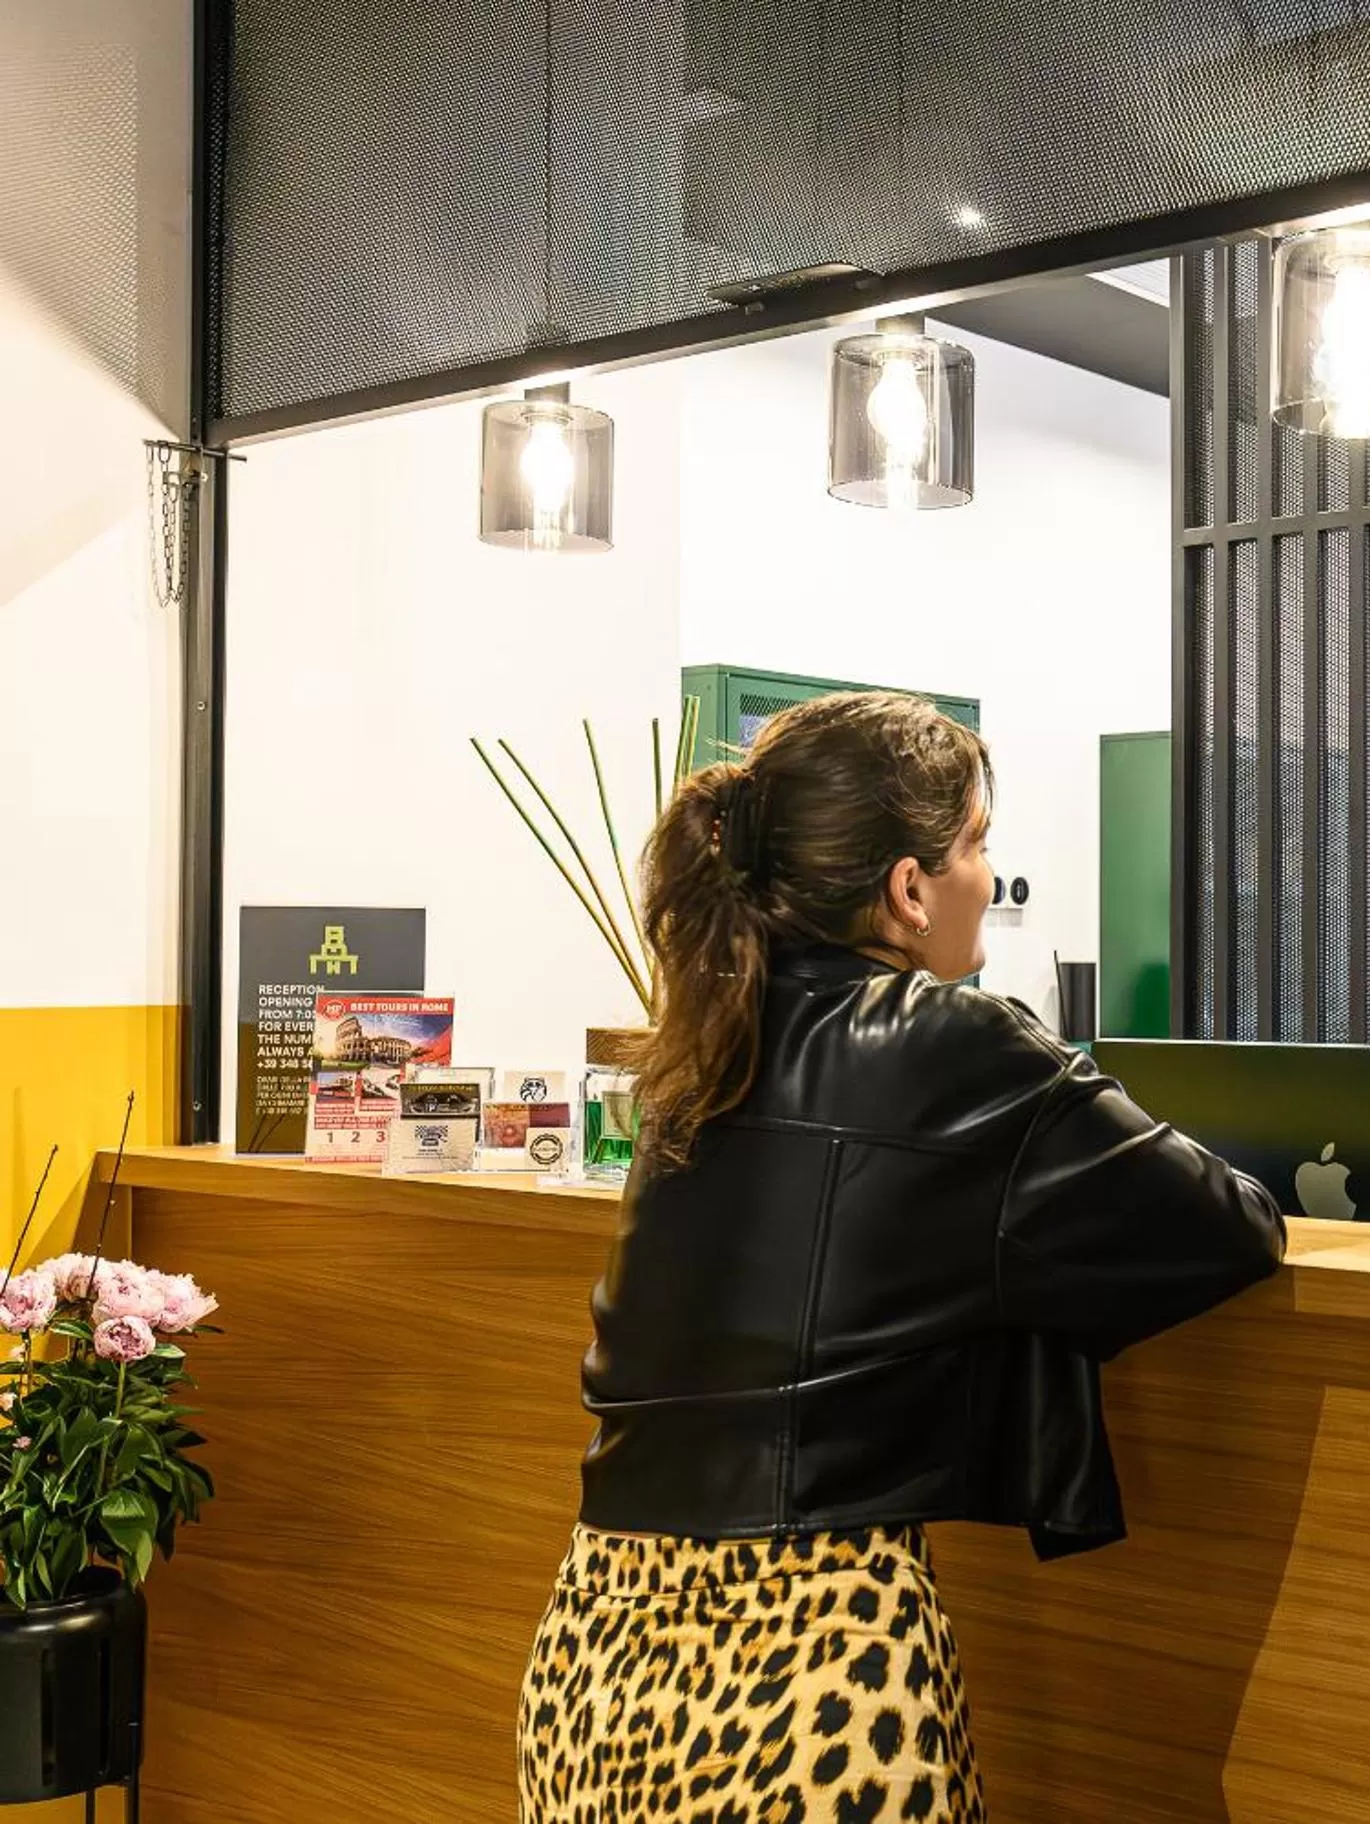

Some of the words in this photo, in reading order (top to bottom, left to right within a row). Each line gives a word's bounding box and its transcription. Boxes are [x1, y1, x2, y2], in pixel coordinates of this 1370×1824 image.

[259, 984, 325, 995] RECEPTION
[259, 997, 313, 1007] OPENING
[350, 1002, 375, 1012] BEST
[377, 1002, 408, 1012] TOURS
[409, 1002, 419, 1012] IN
[420, 1003, 449, 1012] ROME
[259, 1009, 293, 1019] FROM
[259, 1021, 282, 1031] FOR
[284, 1021, 313, 1031] EVER
[257, 1034, 280, 1044] THE
[284, 1034, 312, 1044] NUM
[257, 1046, 304, 1057] ALWAYS
[326, 1131, 334, 1143] 1
[351, 1131, 361, 1143] 2
[376, 1131, 386, 1143] 3
